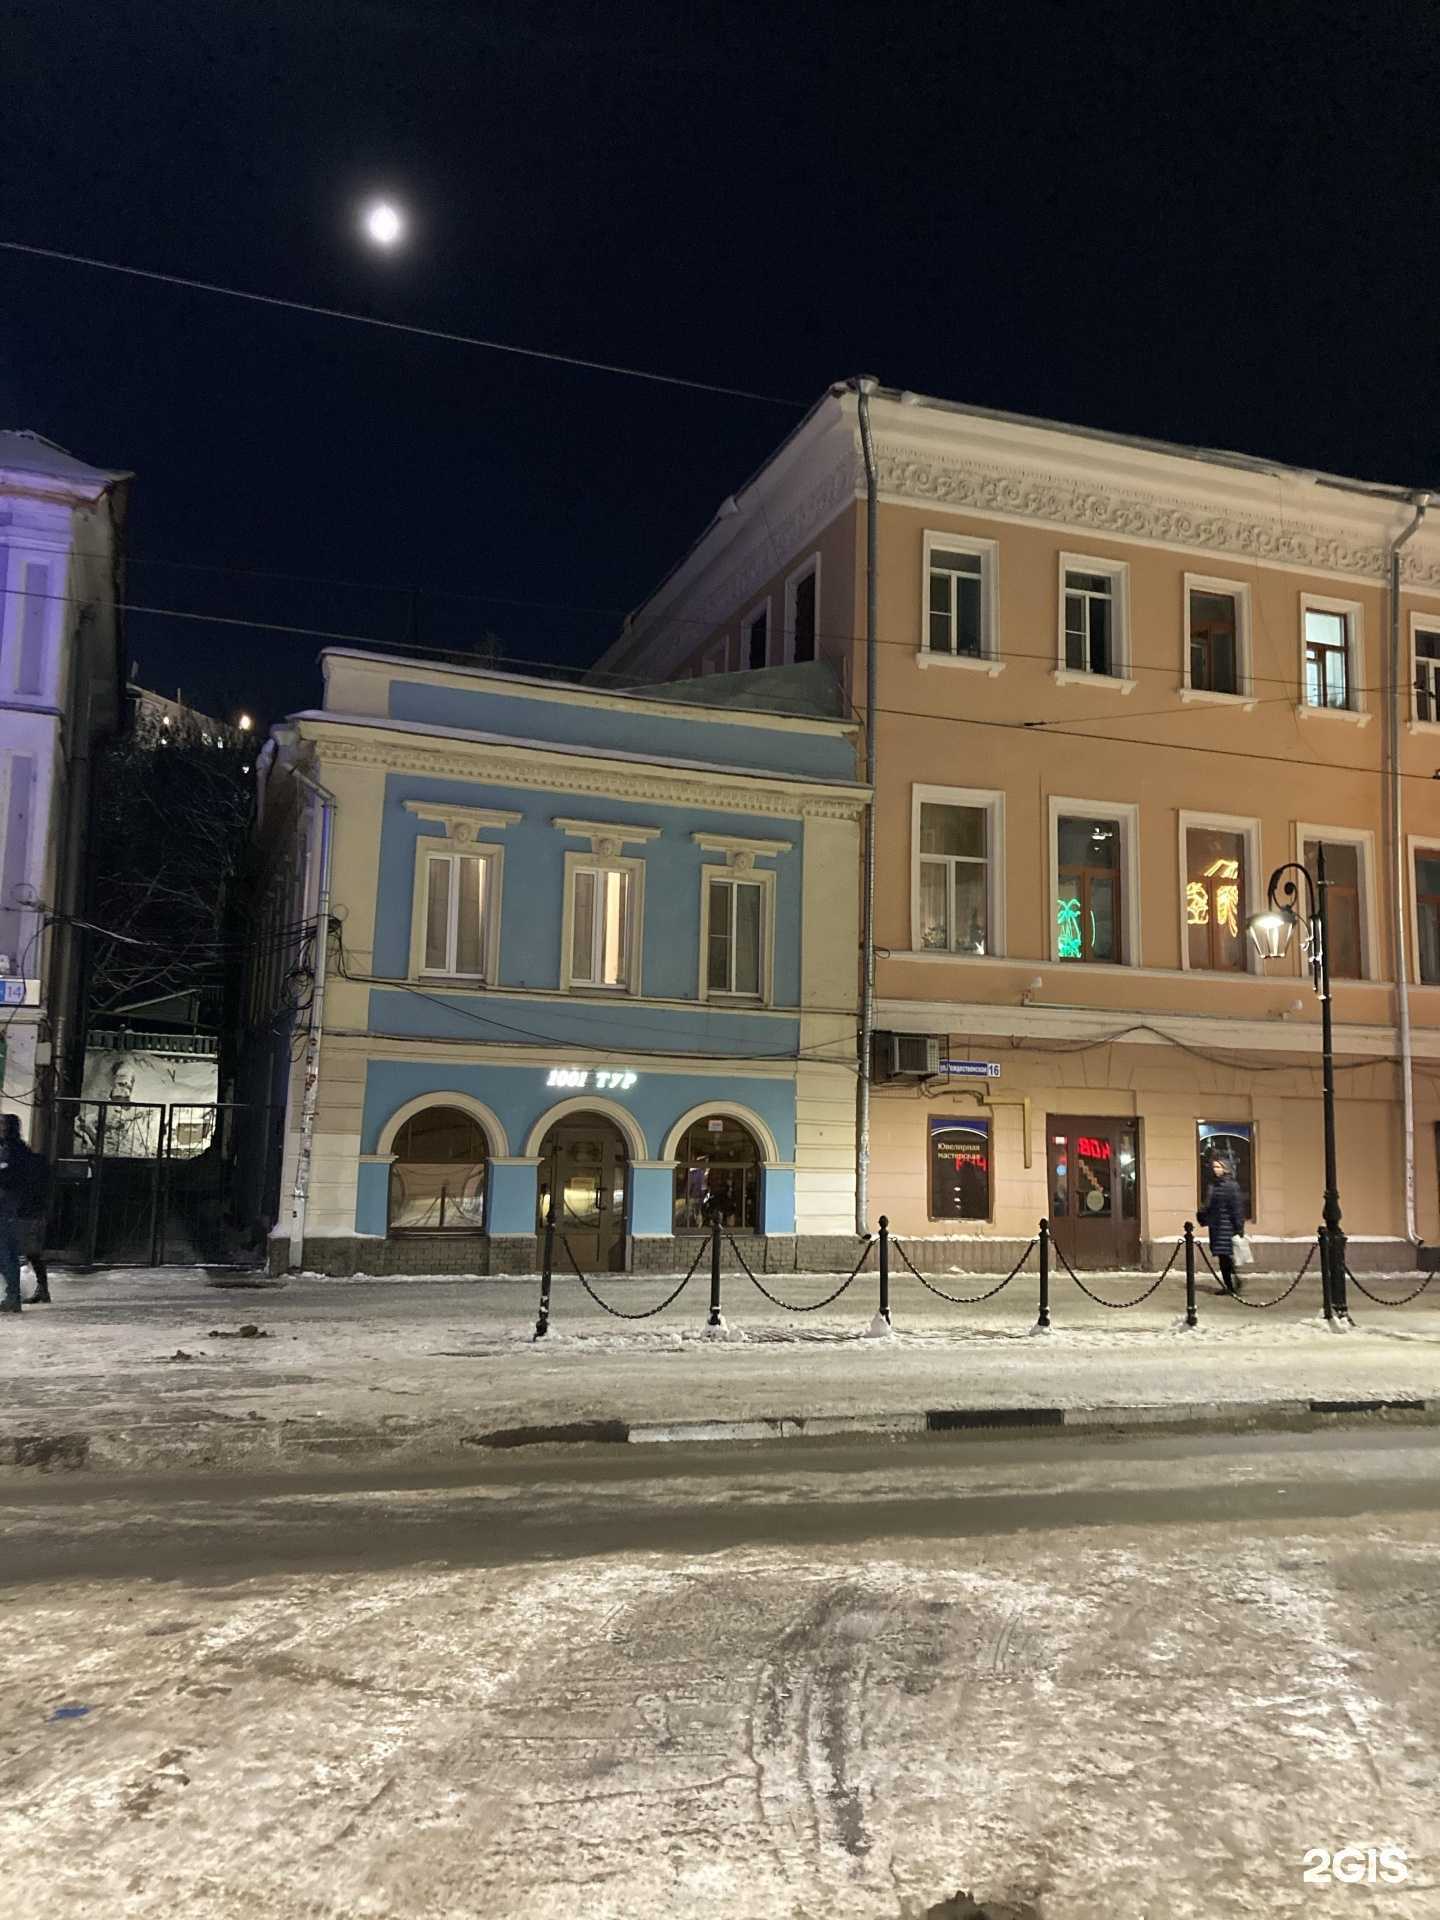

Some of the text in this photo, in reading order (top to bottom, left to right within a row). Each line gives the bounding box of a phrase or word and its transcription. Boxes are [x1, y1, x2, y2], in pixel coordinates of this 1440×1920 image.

[8, 986, 21, 998] 14
[989, 1064, 999, 1076] 16
[546, 1069, 588, 1088] 1001
[937, 1143, 980, 1152] Ювелирная
